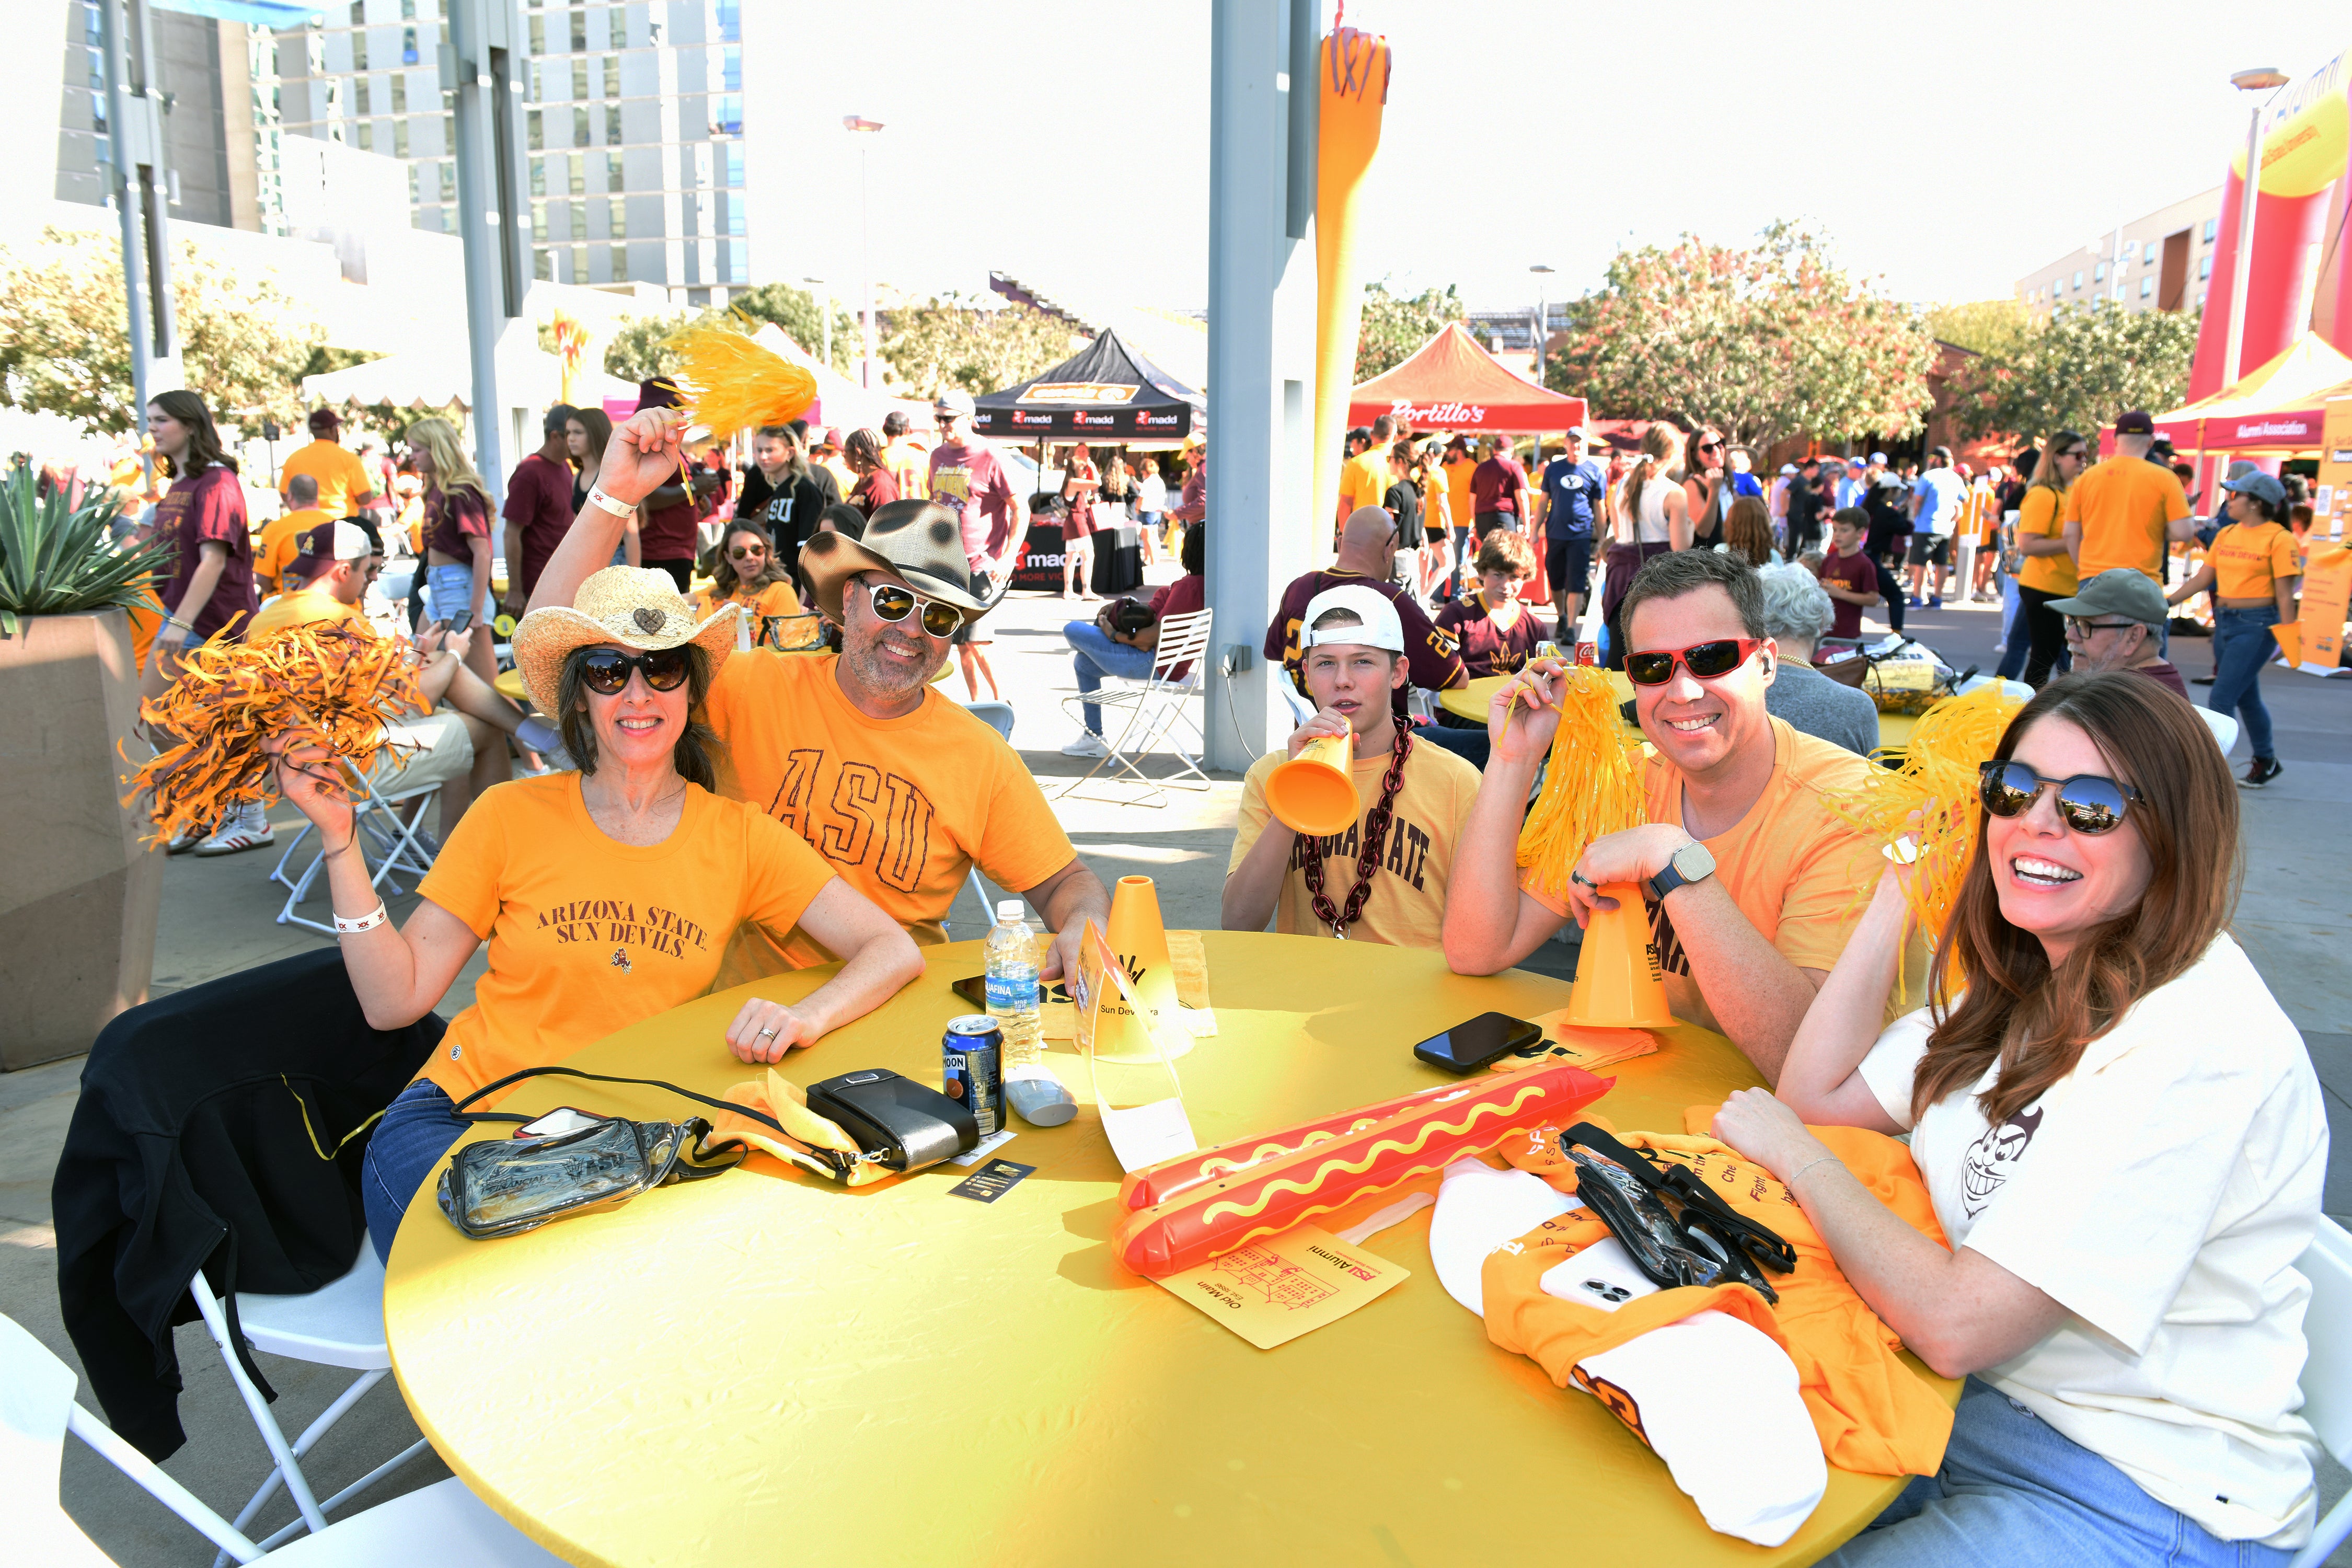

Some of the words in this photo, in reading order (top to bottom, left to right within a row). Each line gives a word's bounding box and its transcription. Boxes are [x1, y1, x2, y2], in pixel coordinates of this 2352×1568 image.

[1390, 399, 1485, 423] Portillo's
[1024, 414, 1052, 424] madd
[1085, 415, 1114, 424] madd
[1148, 415, 1177, 424] madd
[1567, 477, 1577, 487] Y
[1019, 572, 1045, 581] MORE
[768, 748, 935, 894] ASU
[536, 900, 636, 930] ARIZONA
[645, 906, 707, 950] STATE
[557, 922, 601, 944] SUN
[609, 922, 685, 958] DEVILS
[1101, 1005, 1115, 1014] Sun
[1118, 1007, 1135, 1016] Dev
[1306, 1245, 1353, 1270] Alumni
[1347, 1266, 1377, 1282] ASU
[1197, 1281, 1220, 1298] Main
[1221, 1294, 1241, 1309] Old
